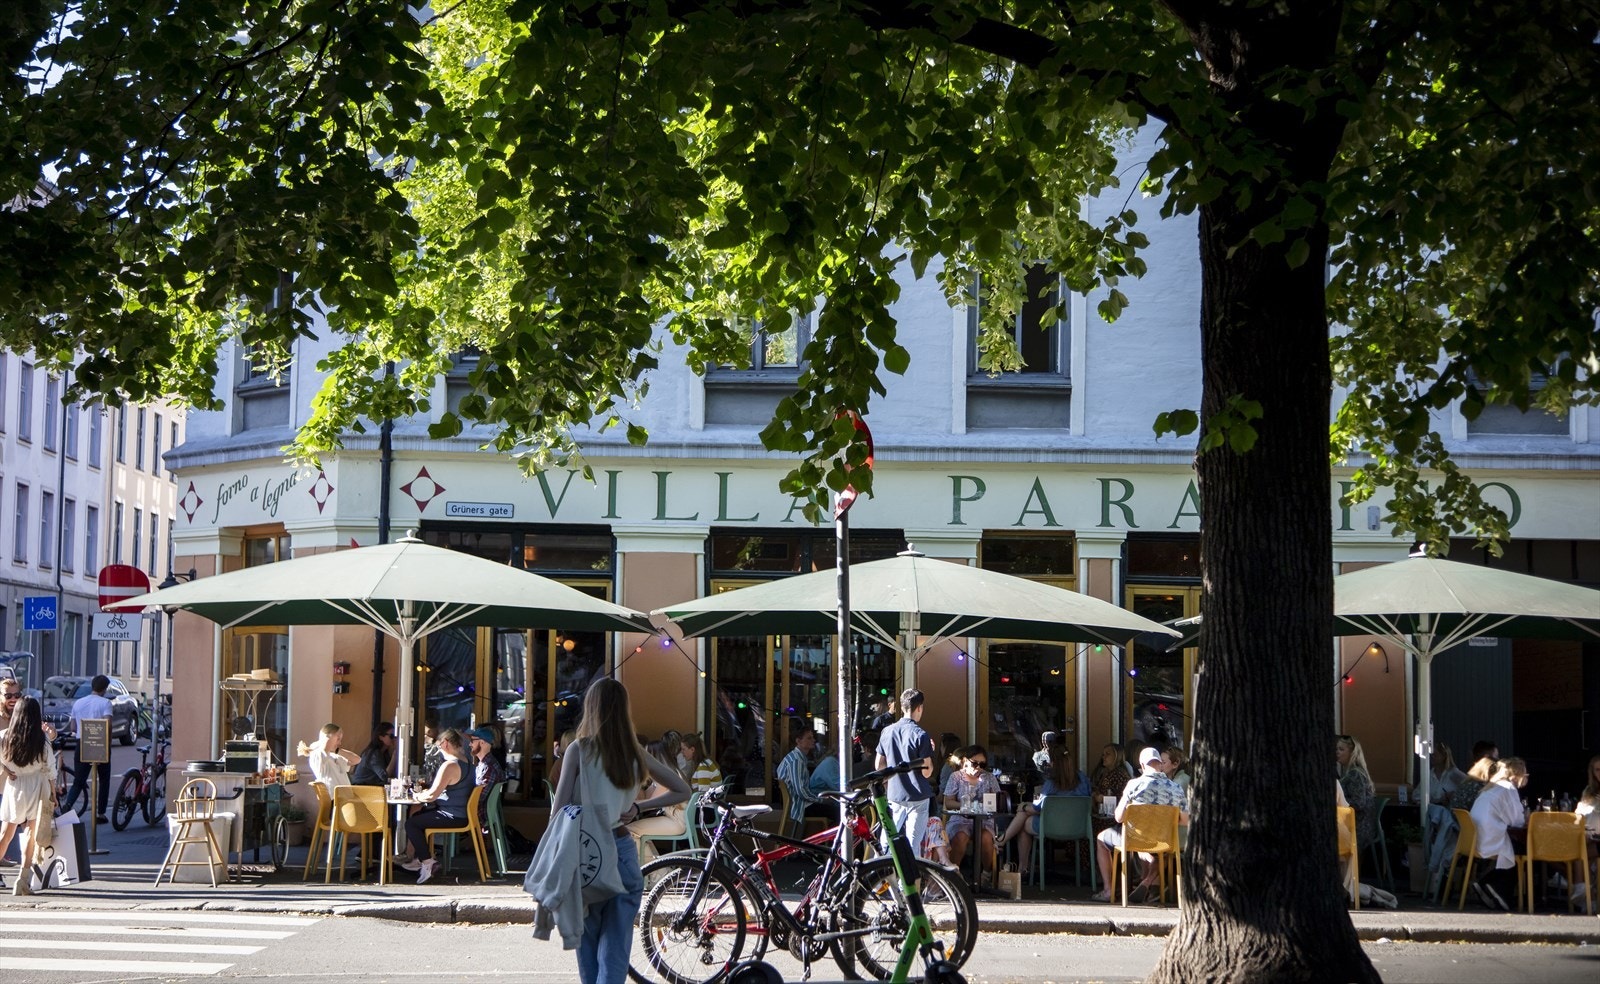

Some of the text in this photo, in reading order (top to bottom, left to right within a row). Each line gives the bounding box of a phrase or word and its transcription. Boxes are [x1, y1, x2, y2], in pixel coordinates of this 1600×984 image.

[211, 470, 298, 524] forno a legna
[451, 504, 509, 517] Grüners gate
[947, 475, 1521, 532] PARAIO
